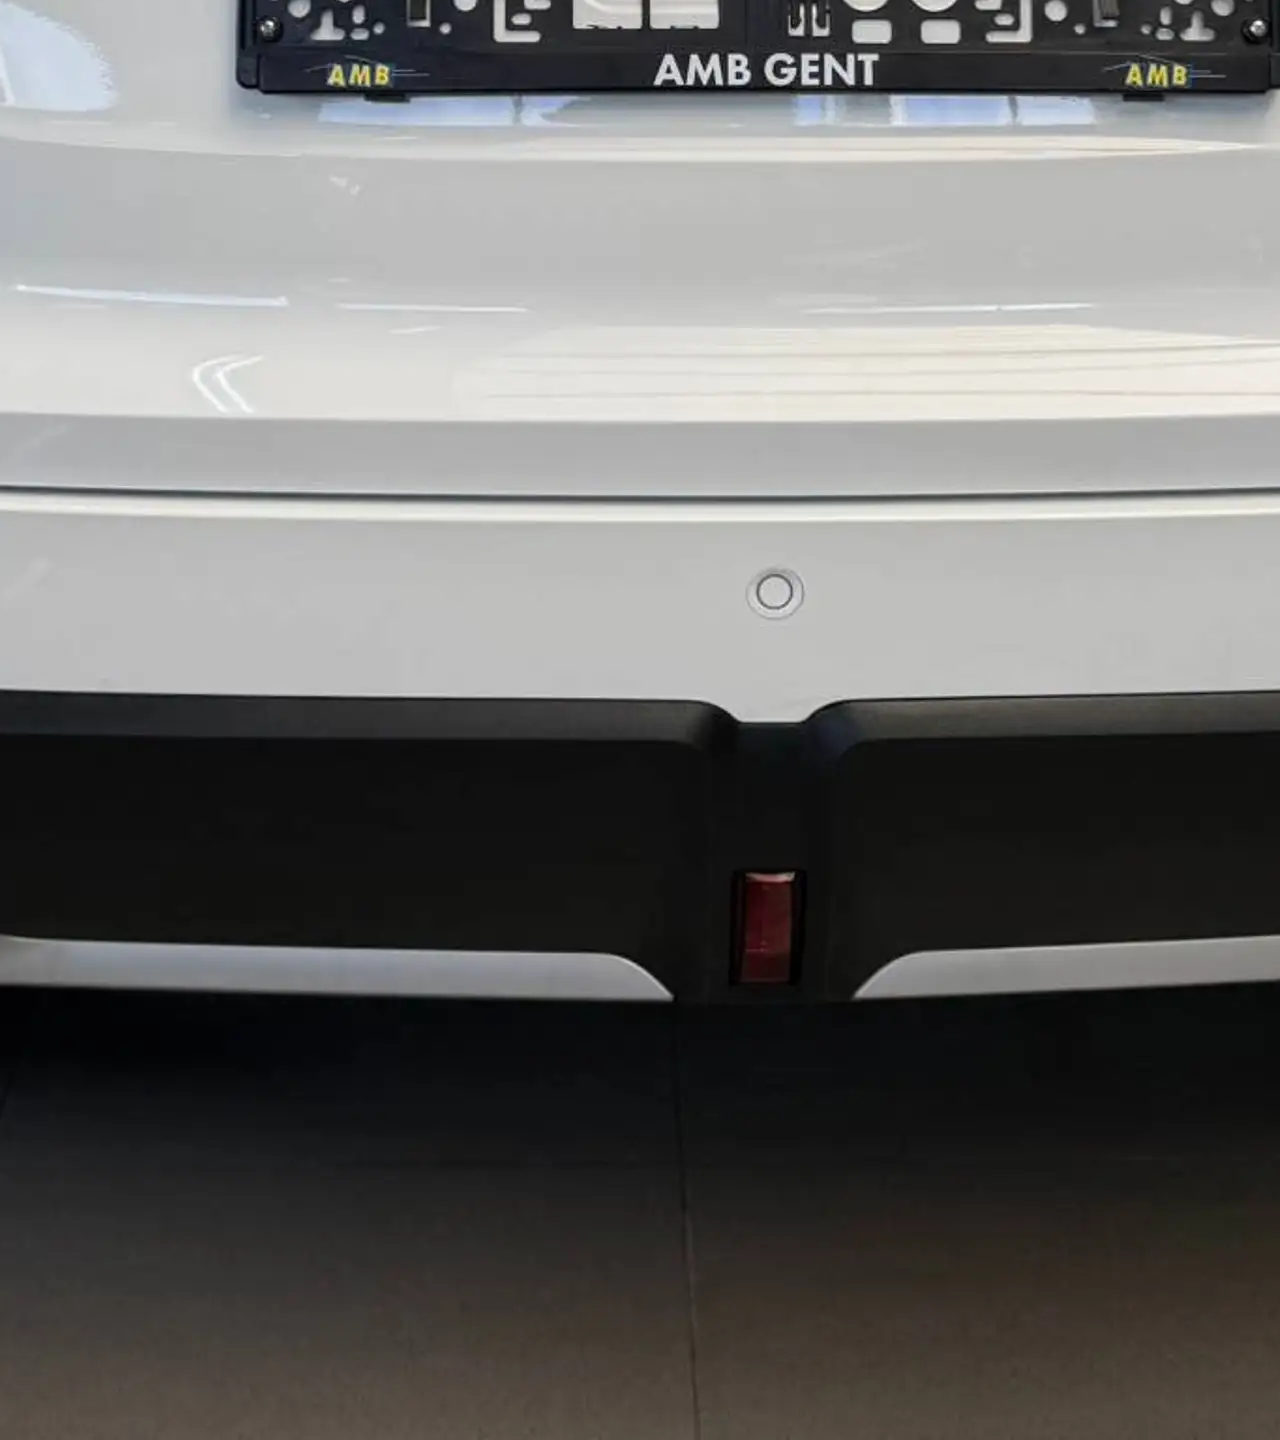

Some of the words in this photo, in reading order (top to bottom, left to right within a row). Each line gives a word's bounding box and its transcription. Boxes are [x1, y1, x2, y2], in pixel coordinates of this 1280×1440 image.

[326, 62, 390, 88] AMB
[653, 53, 751, 86] AMB
[763, 52, 880, 86] GENT
[1124, 62, 1189, 88] AMB
